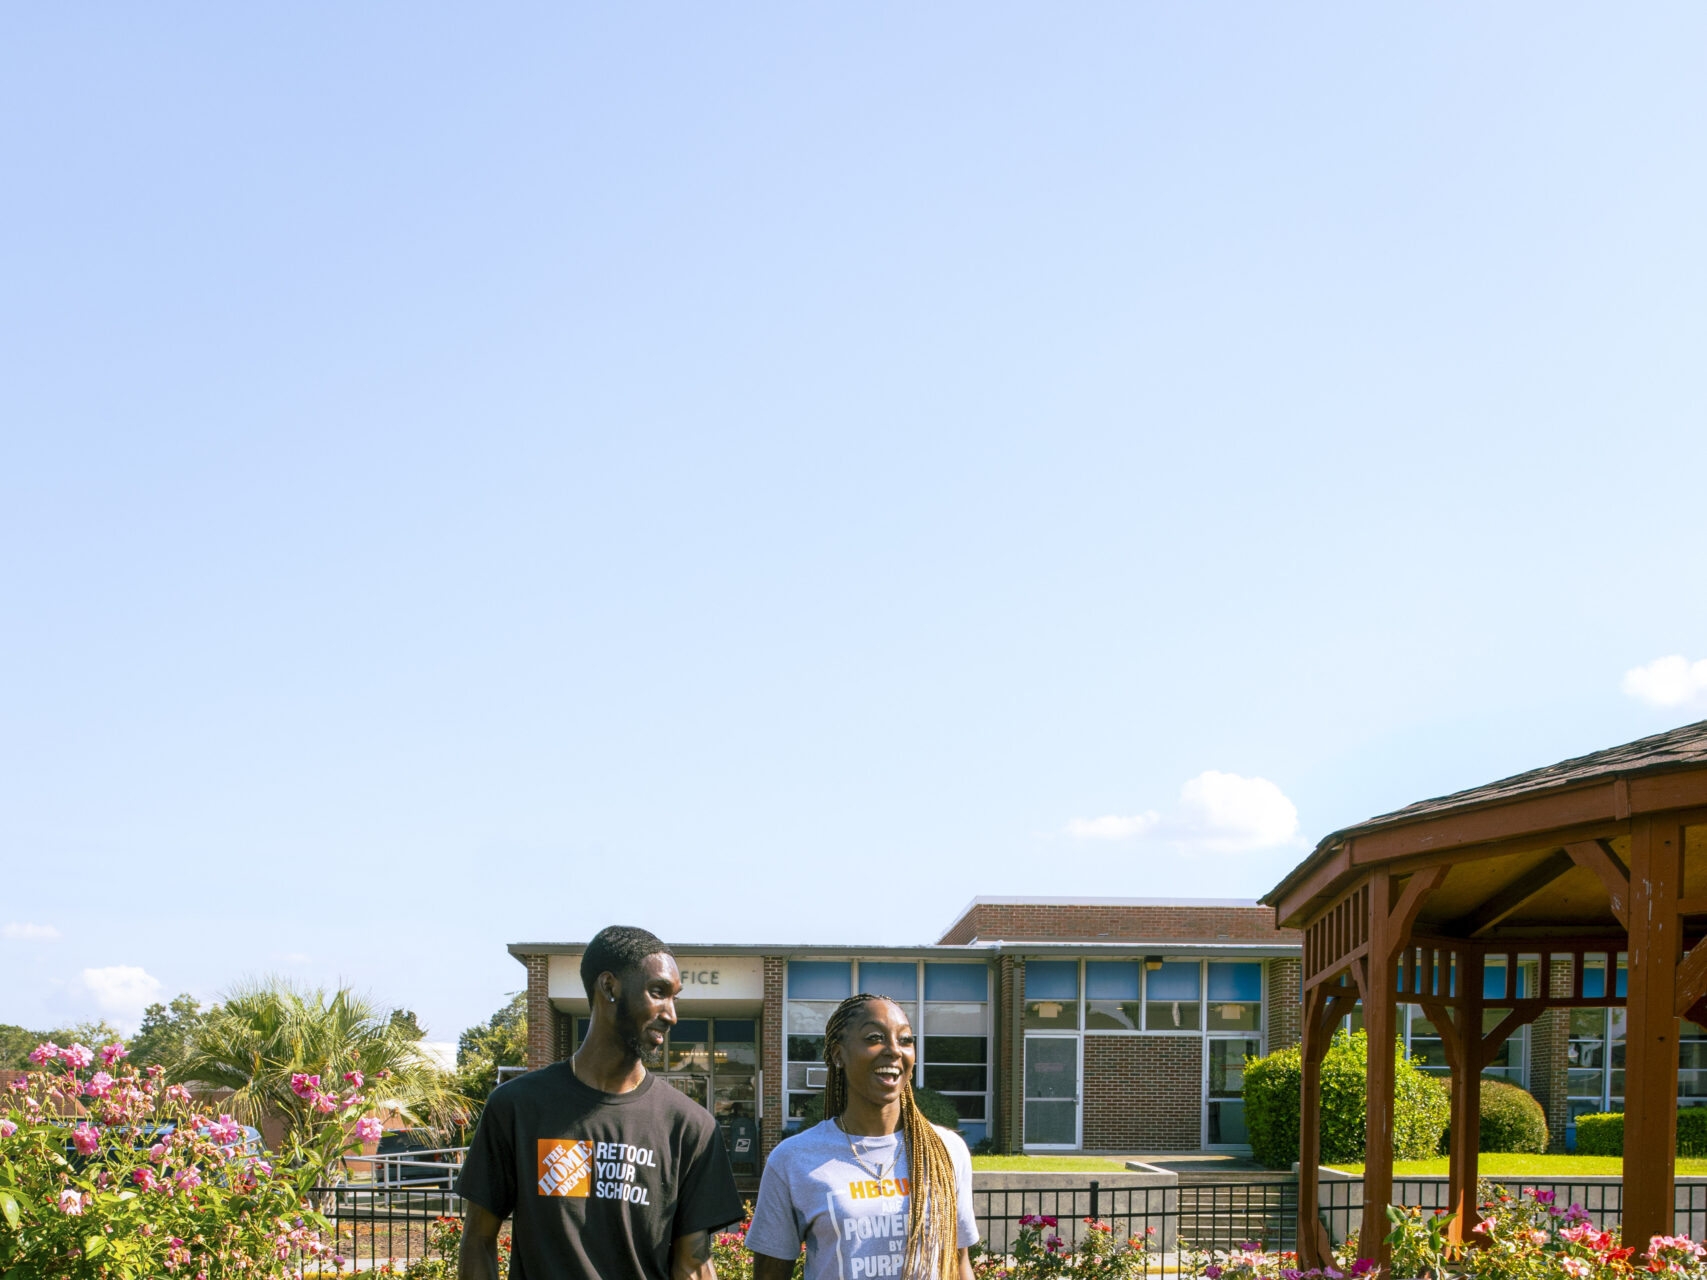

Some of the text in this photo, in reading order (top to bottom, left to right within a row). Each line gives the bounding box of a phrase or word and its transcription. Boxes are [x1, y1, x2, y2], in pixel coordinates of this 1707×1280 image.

[680, 970, 720, 985] FICE
[542, 1144, 567, 1168] THE
[596, 1141, 656, 1168] RETOOL
[538, 1140, 592, 1196] HOME
[557, 1161, 591, 1196] DEPOT
[596, 1161, 636, 1183] YOUR
[595, 1181, 650, 1206] SCHOOL
[849, 1177, 910, 1199] HBCU
[843, 1213, 930, 1240] POWE
[888, 1240, 903, 1252] BY
[850, 1253, 907, 1280] PURP
